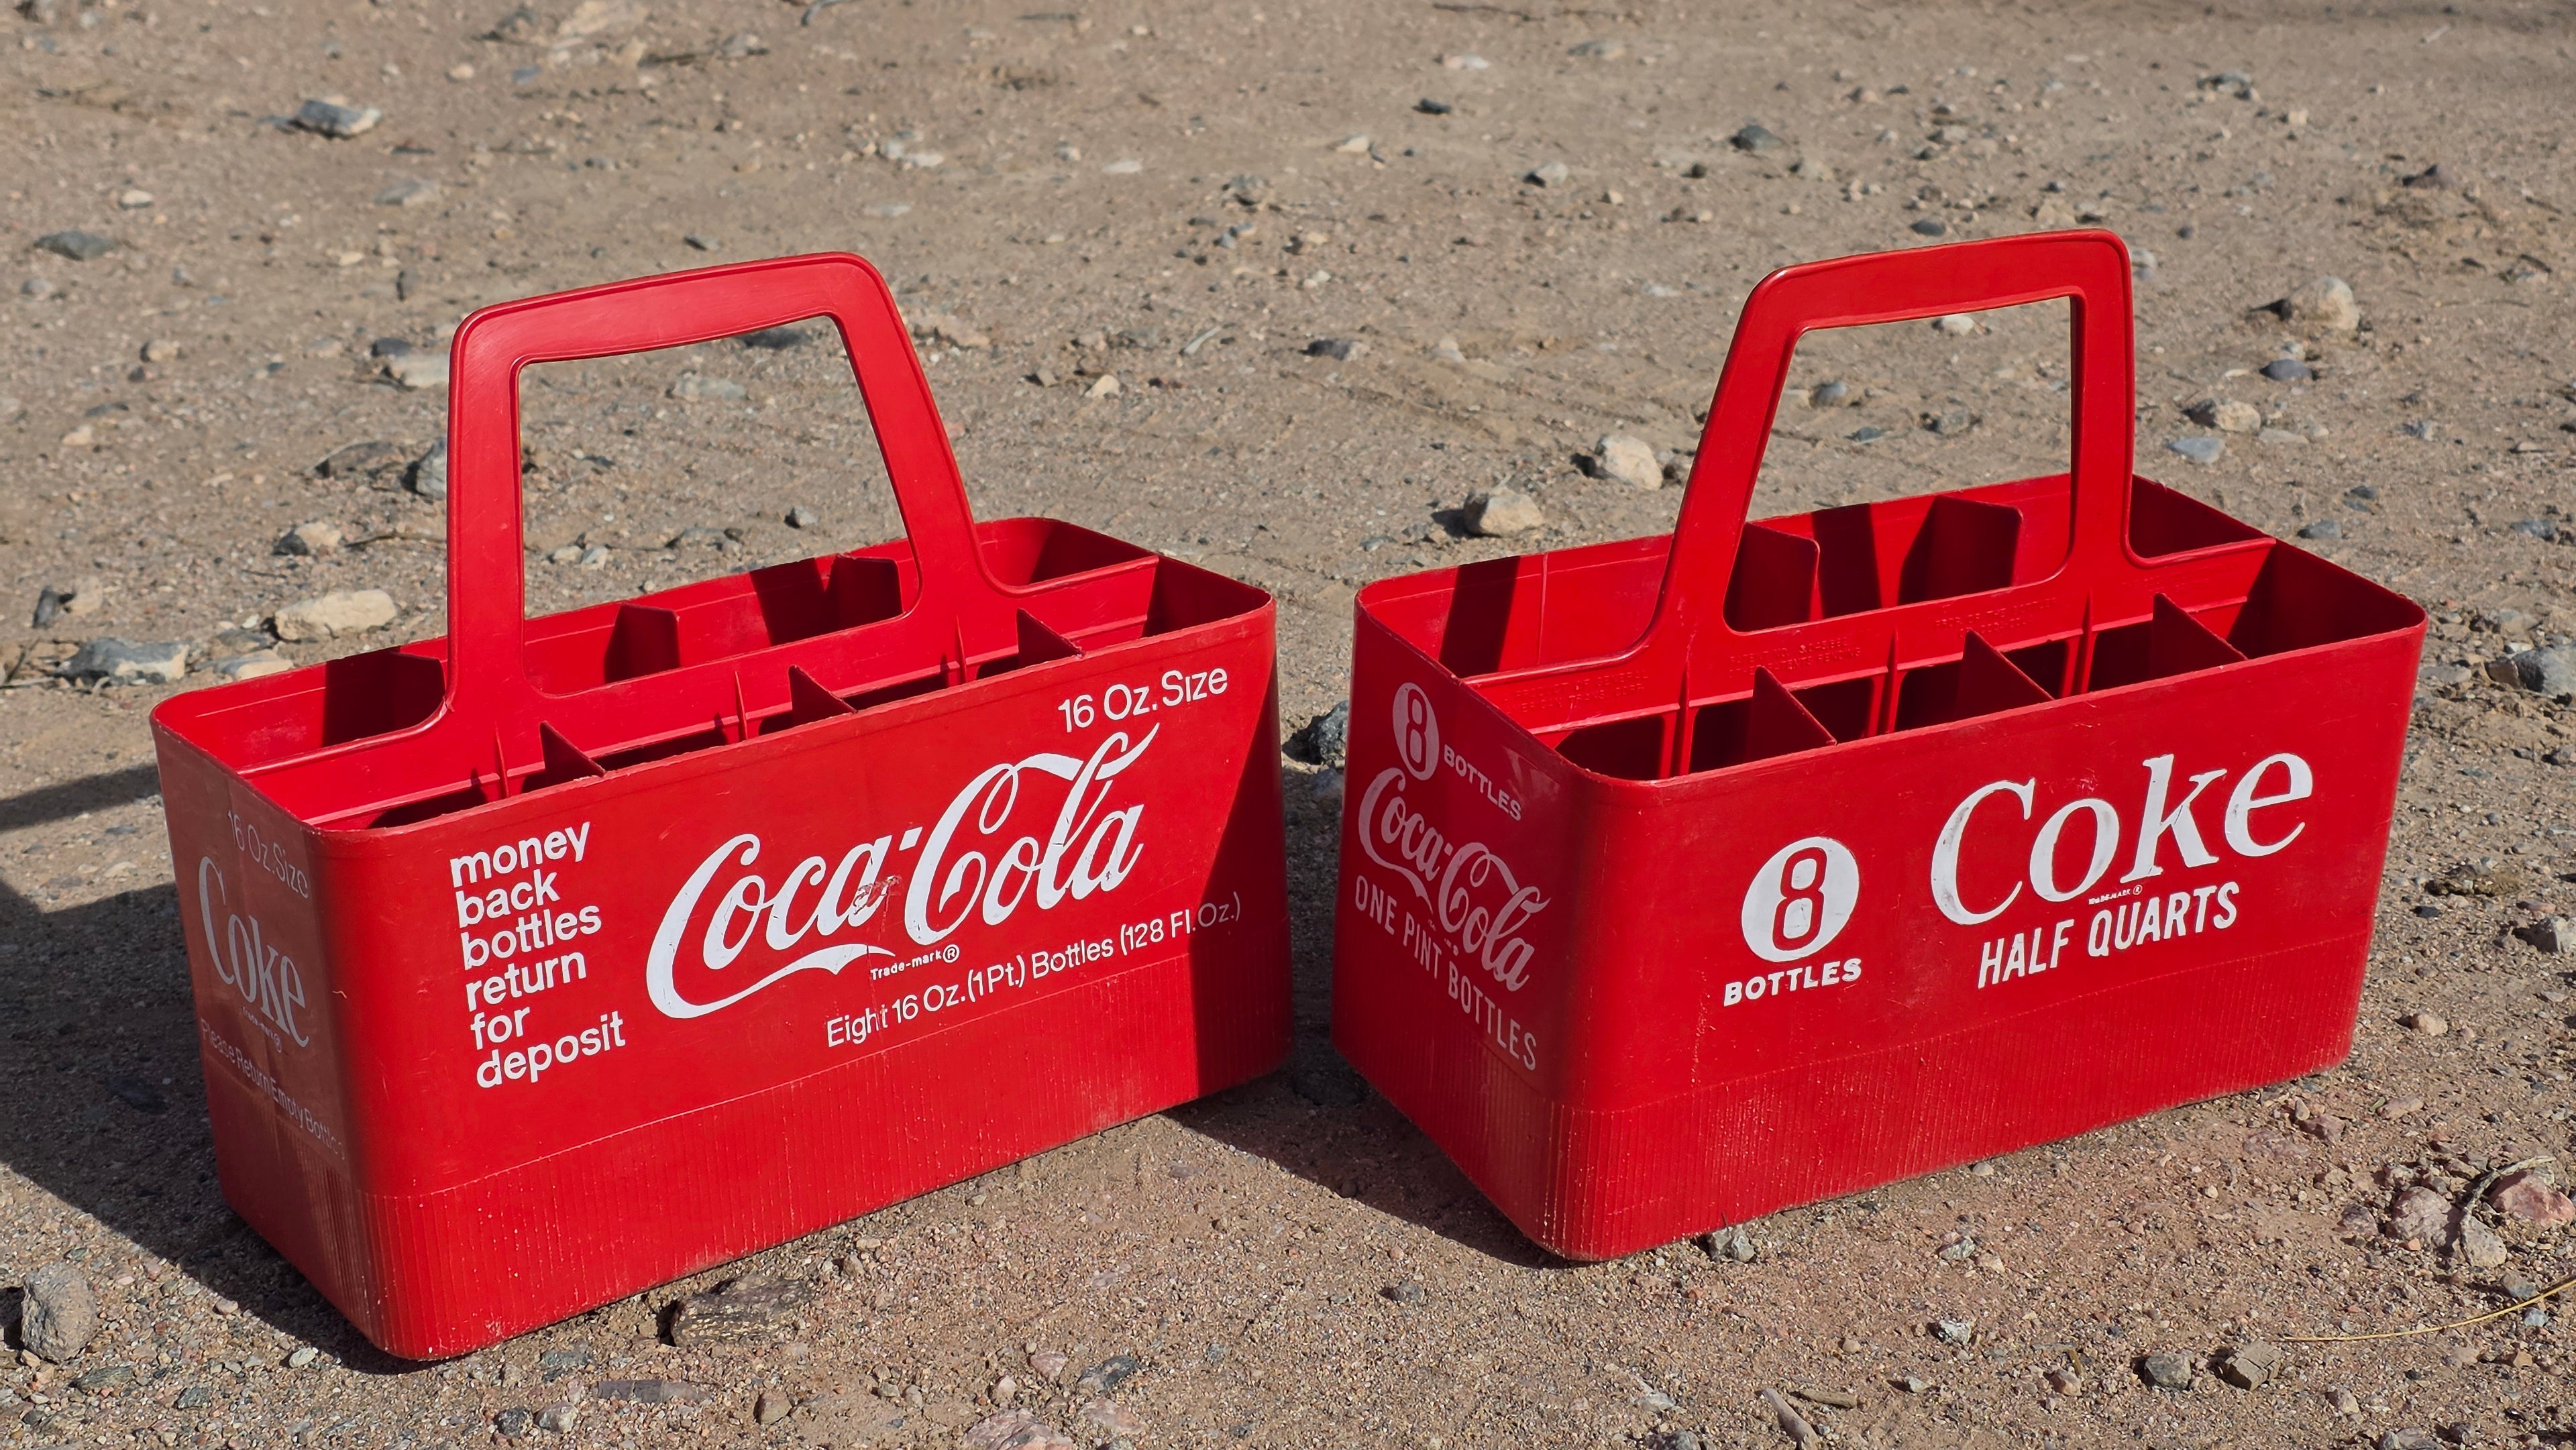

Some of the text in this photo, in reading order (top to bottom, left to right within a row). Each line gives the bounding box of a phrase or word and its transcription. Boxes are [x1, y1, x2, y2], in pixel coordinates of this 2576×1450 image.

[1058, 668, 1228, 733] 16 Oz. Size
[1444, 744, 1522, 822] BOTTLES
[227, 810, 309, 899] 16 Oz. Size
[450, 822, 590, 888] money
[646, 722, 1160, 1019] Coca-Cola
[1358, 767, 1552, 992] Coca-Cola
[1931, 752, 2314, 926] Coke
[456, 869, 561, 928] back
[461, 905, 602, 970] bottles
[1978, 881, 2241, 989] HALF QUARTS
[199, 856, 309, 1048] Coke
[466, 951, 587, 1013] return
[826, 1004, 888, 1048] Eight
[892, 995, 918, 1023] 16
[1031, 938, 1114, 979] Bottles
[1120, 918, 1164, 956] (128
[1355, 875, 1395, 936] ONE
[1403, 911, 1442, 980] PINT
[1448, 960, 1538, 1071] BOTTLES
[1723, 958, 1862, 1007] BOTTLES
[470, 1006, 531, 1050] for
[476, 1011, 626, 1089] deposit
[201, 1017, 235, 1064] Please
[235, 1047, 270, 1095] Return
[269, 1077, 303, 1129] Empty
